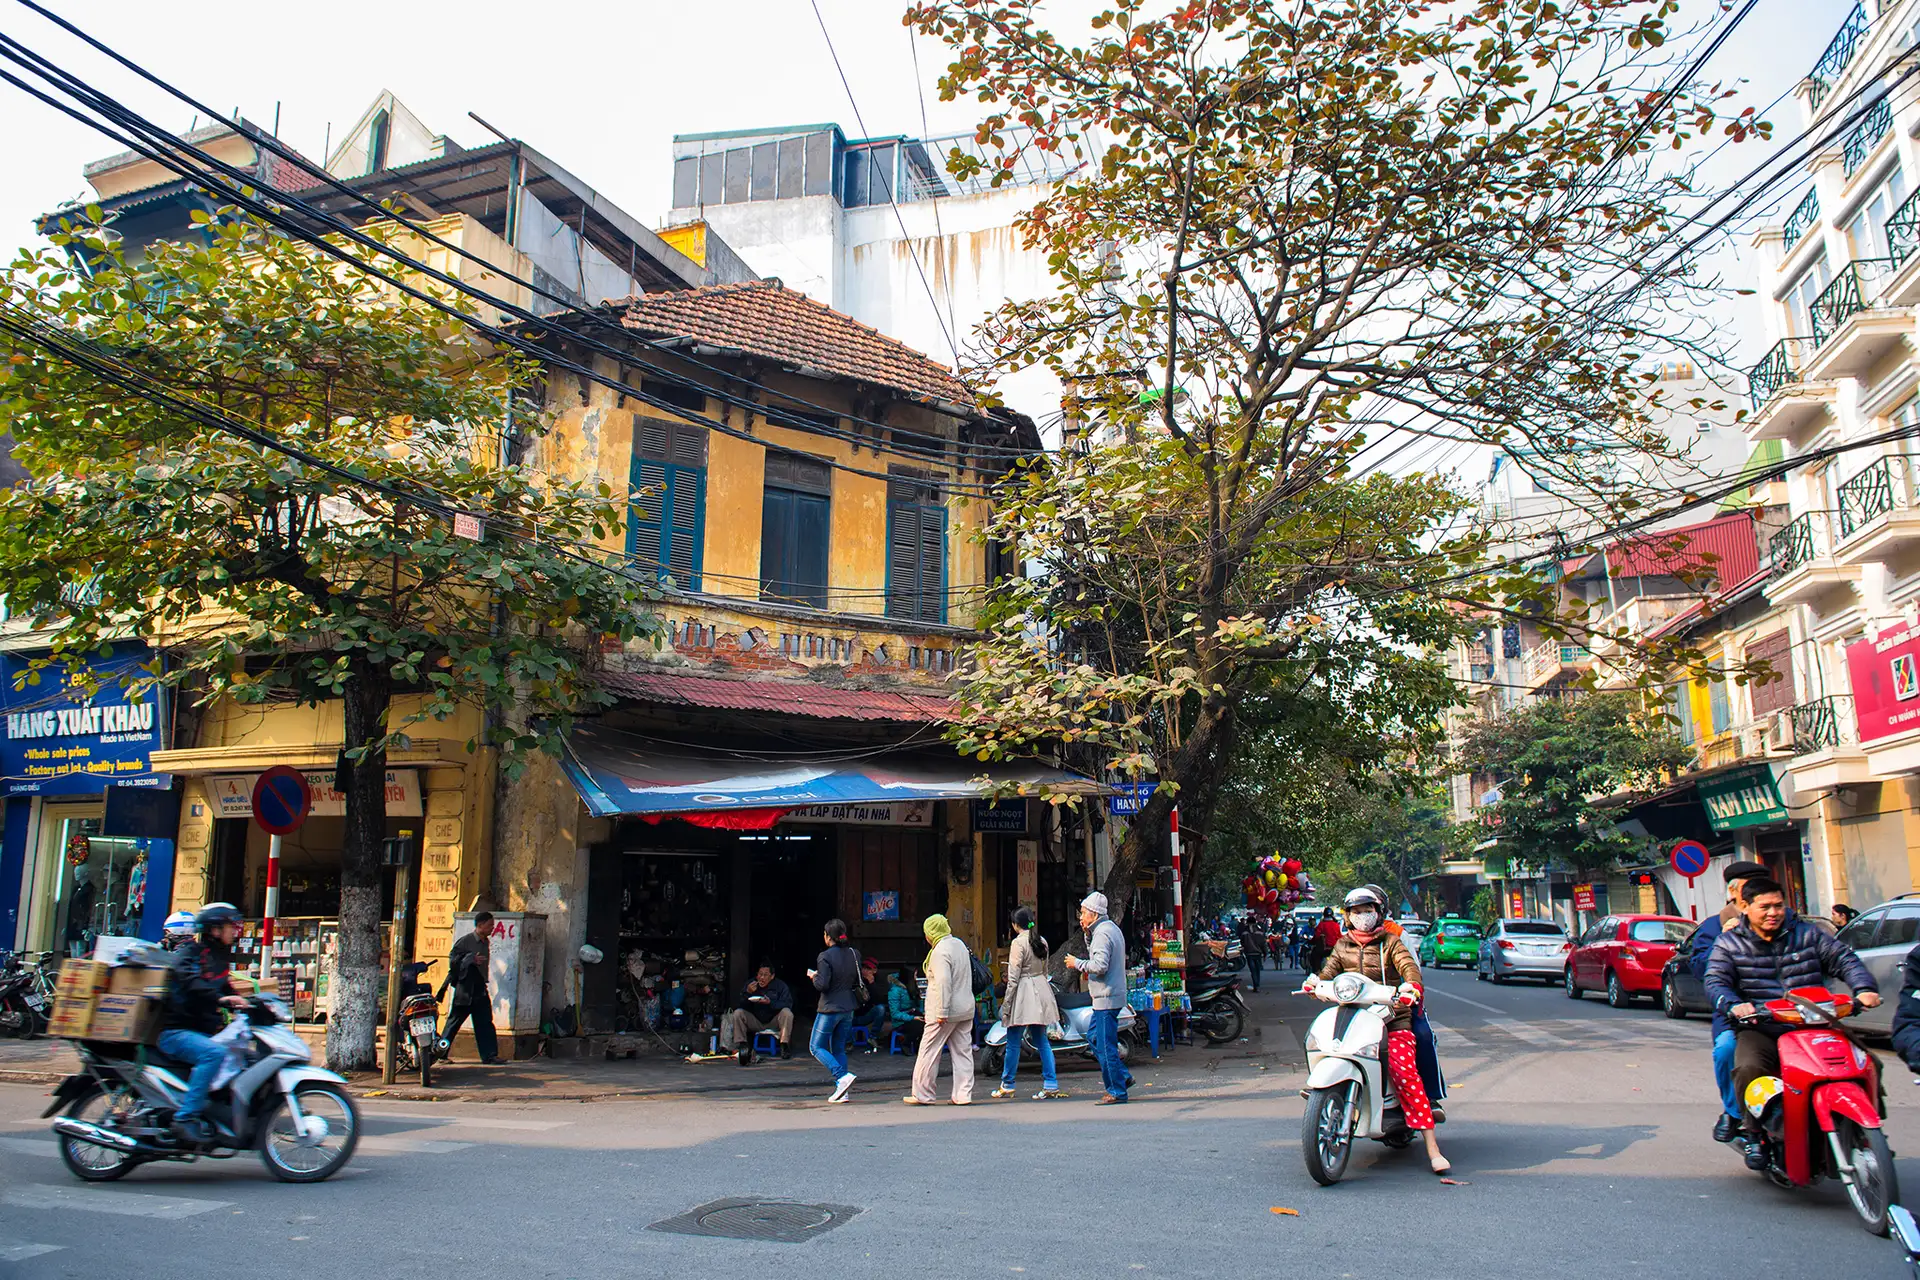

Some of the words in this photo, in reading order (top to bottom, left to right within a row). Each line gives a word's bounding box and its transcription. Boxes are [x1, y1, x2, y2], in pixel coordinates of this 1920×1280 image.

[57, 698, 102, 736] XUẤT
[100, 735, 117, 744] Made
[118, 734, 125, 743] in
[124, 732, 153, 742] VietNam
[27, 748, 51, 759] Whole
[51, 747, 67, 758] sale
[68, 746, 90, 760] prices
[29, 765, 55, 778] Factory
[87, 760, 115, 774] Quality
[116, 758, 143, 771] brands
[1706, 792, 1743, 819] NAM
